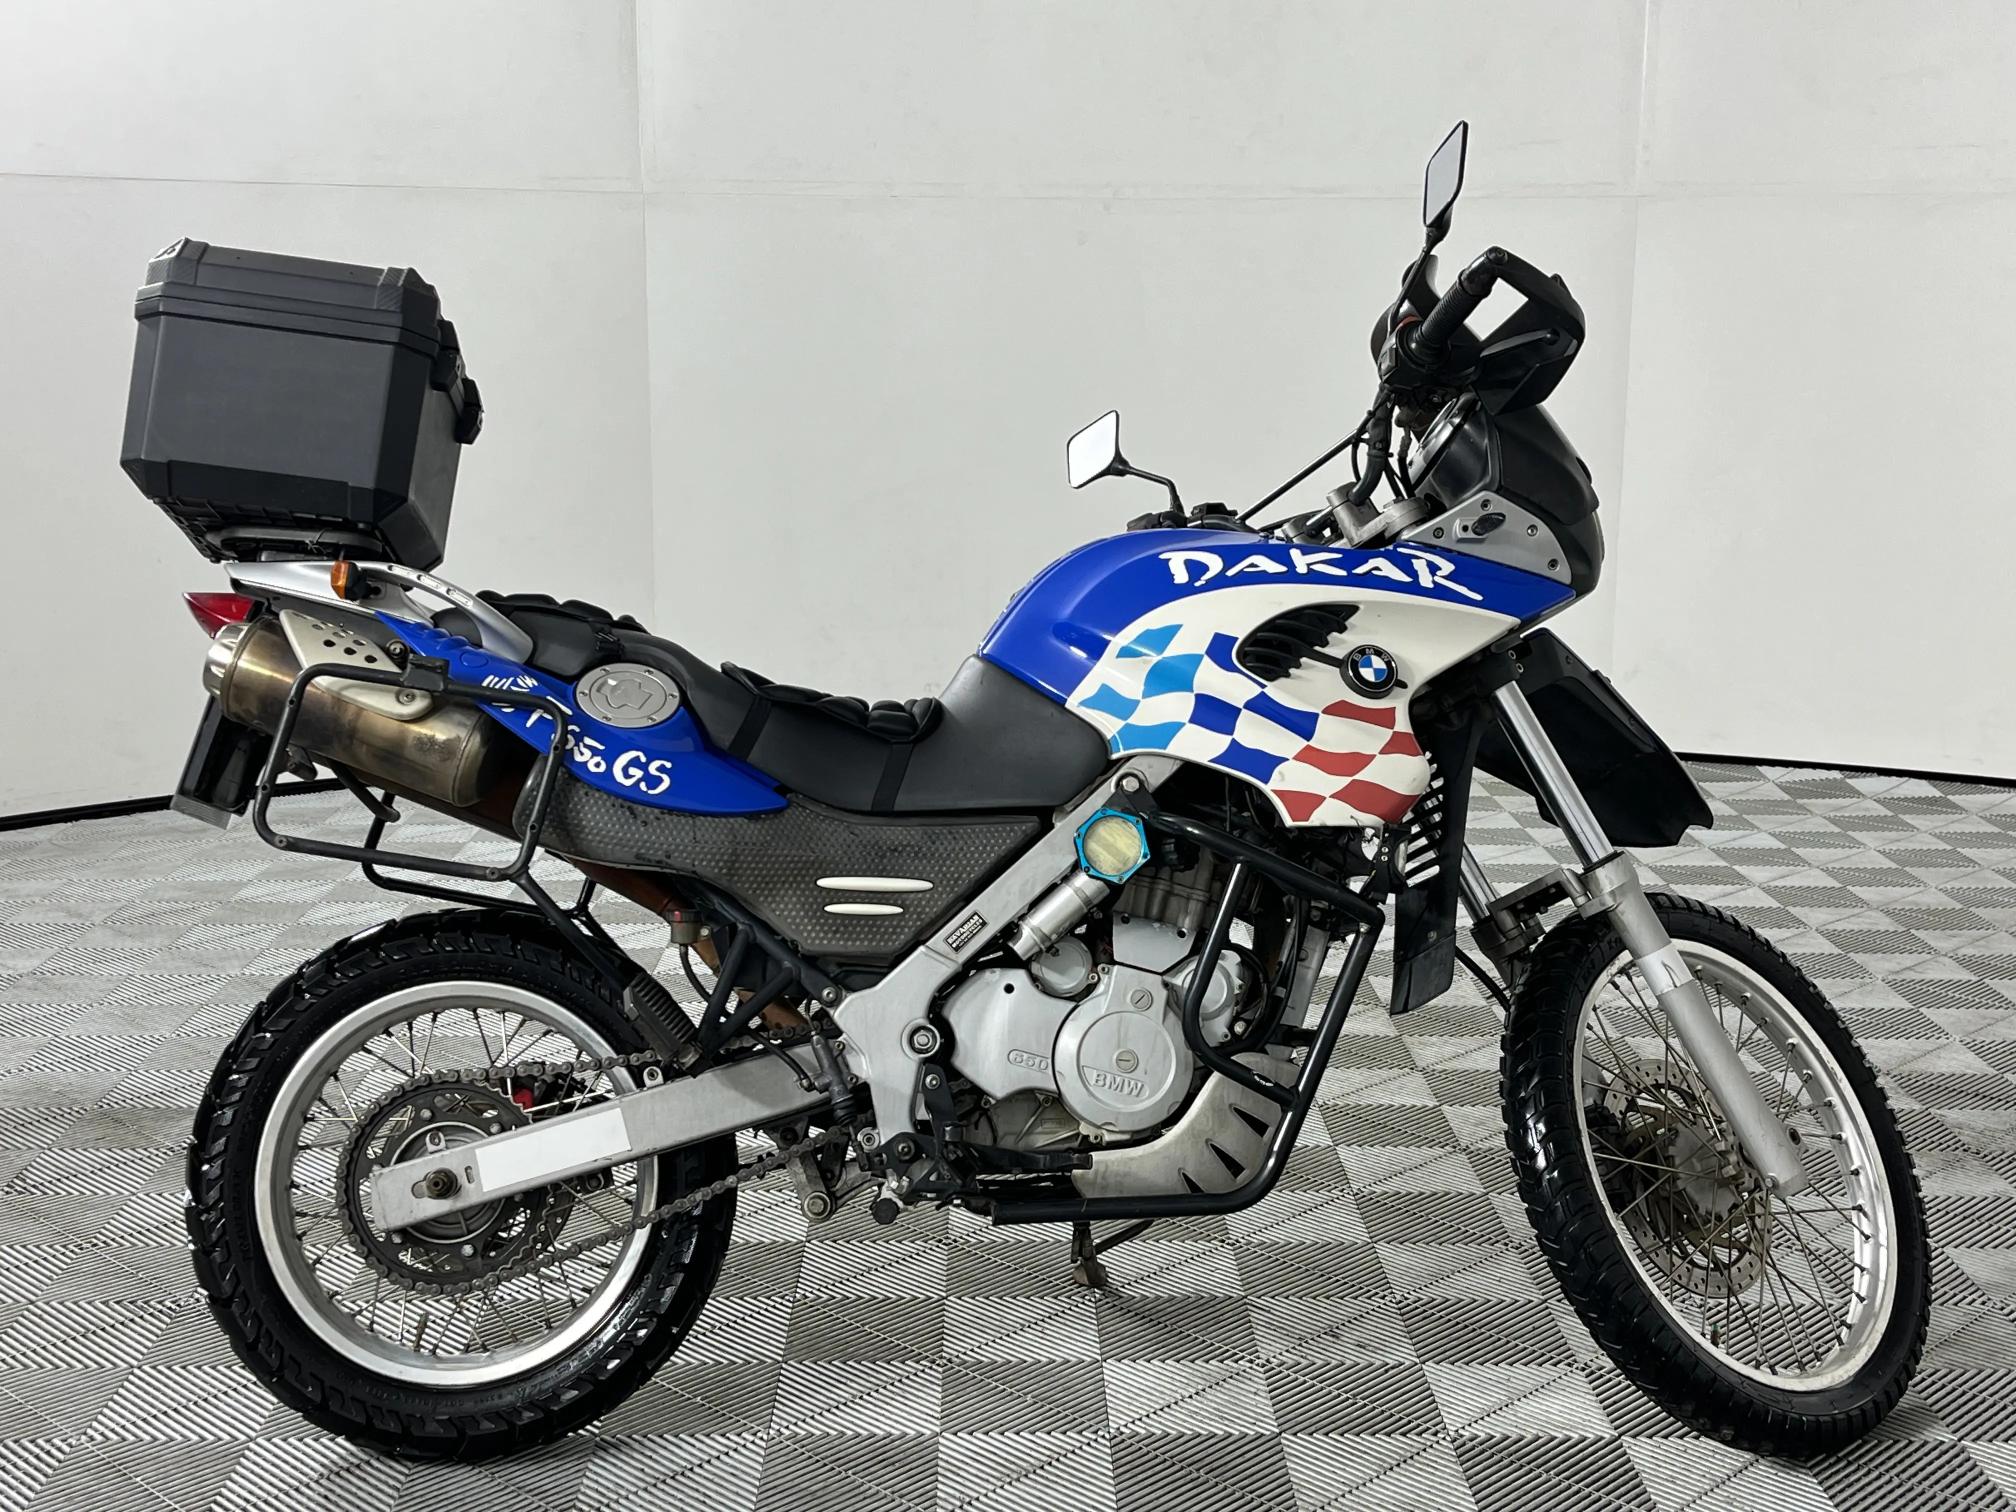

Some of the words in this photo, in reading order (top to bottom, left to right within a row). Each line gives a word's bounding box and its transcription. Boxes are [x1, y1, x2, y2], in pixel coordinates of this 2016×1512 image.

[1158, 547, 1484, 601] DAKAR
[1352, 647, 1392, 662] BMW
[612, 750, 673, 795] GS
[1013, 1052, 1050, 1072] 650
[1092, 1072, 1146, 1099] BMW
